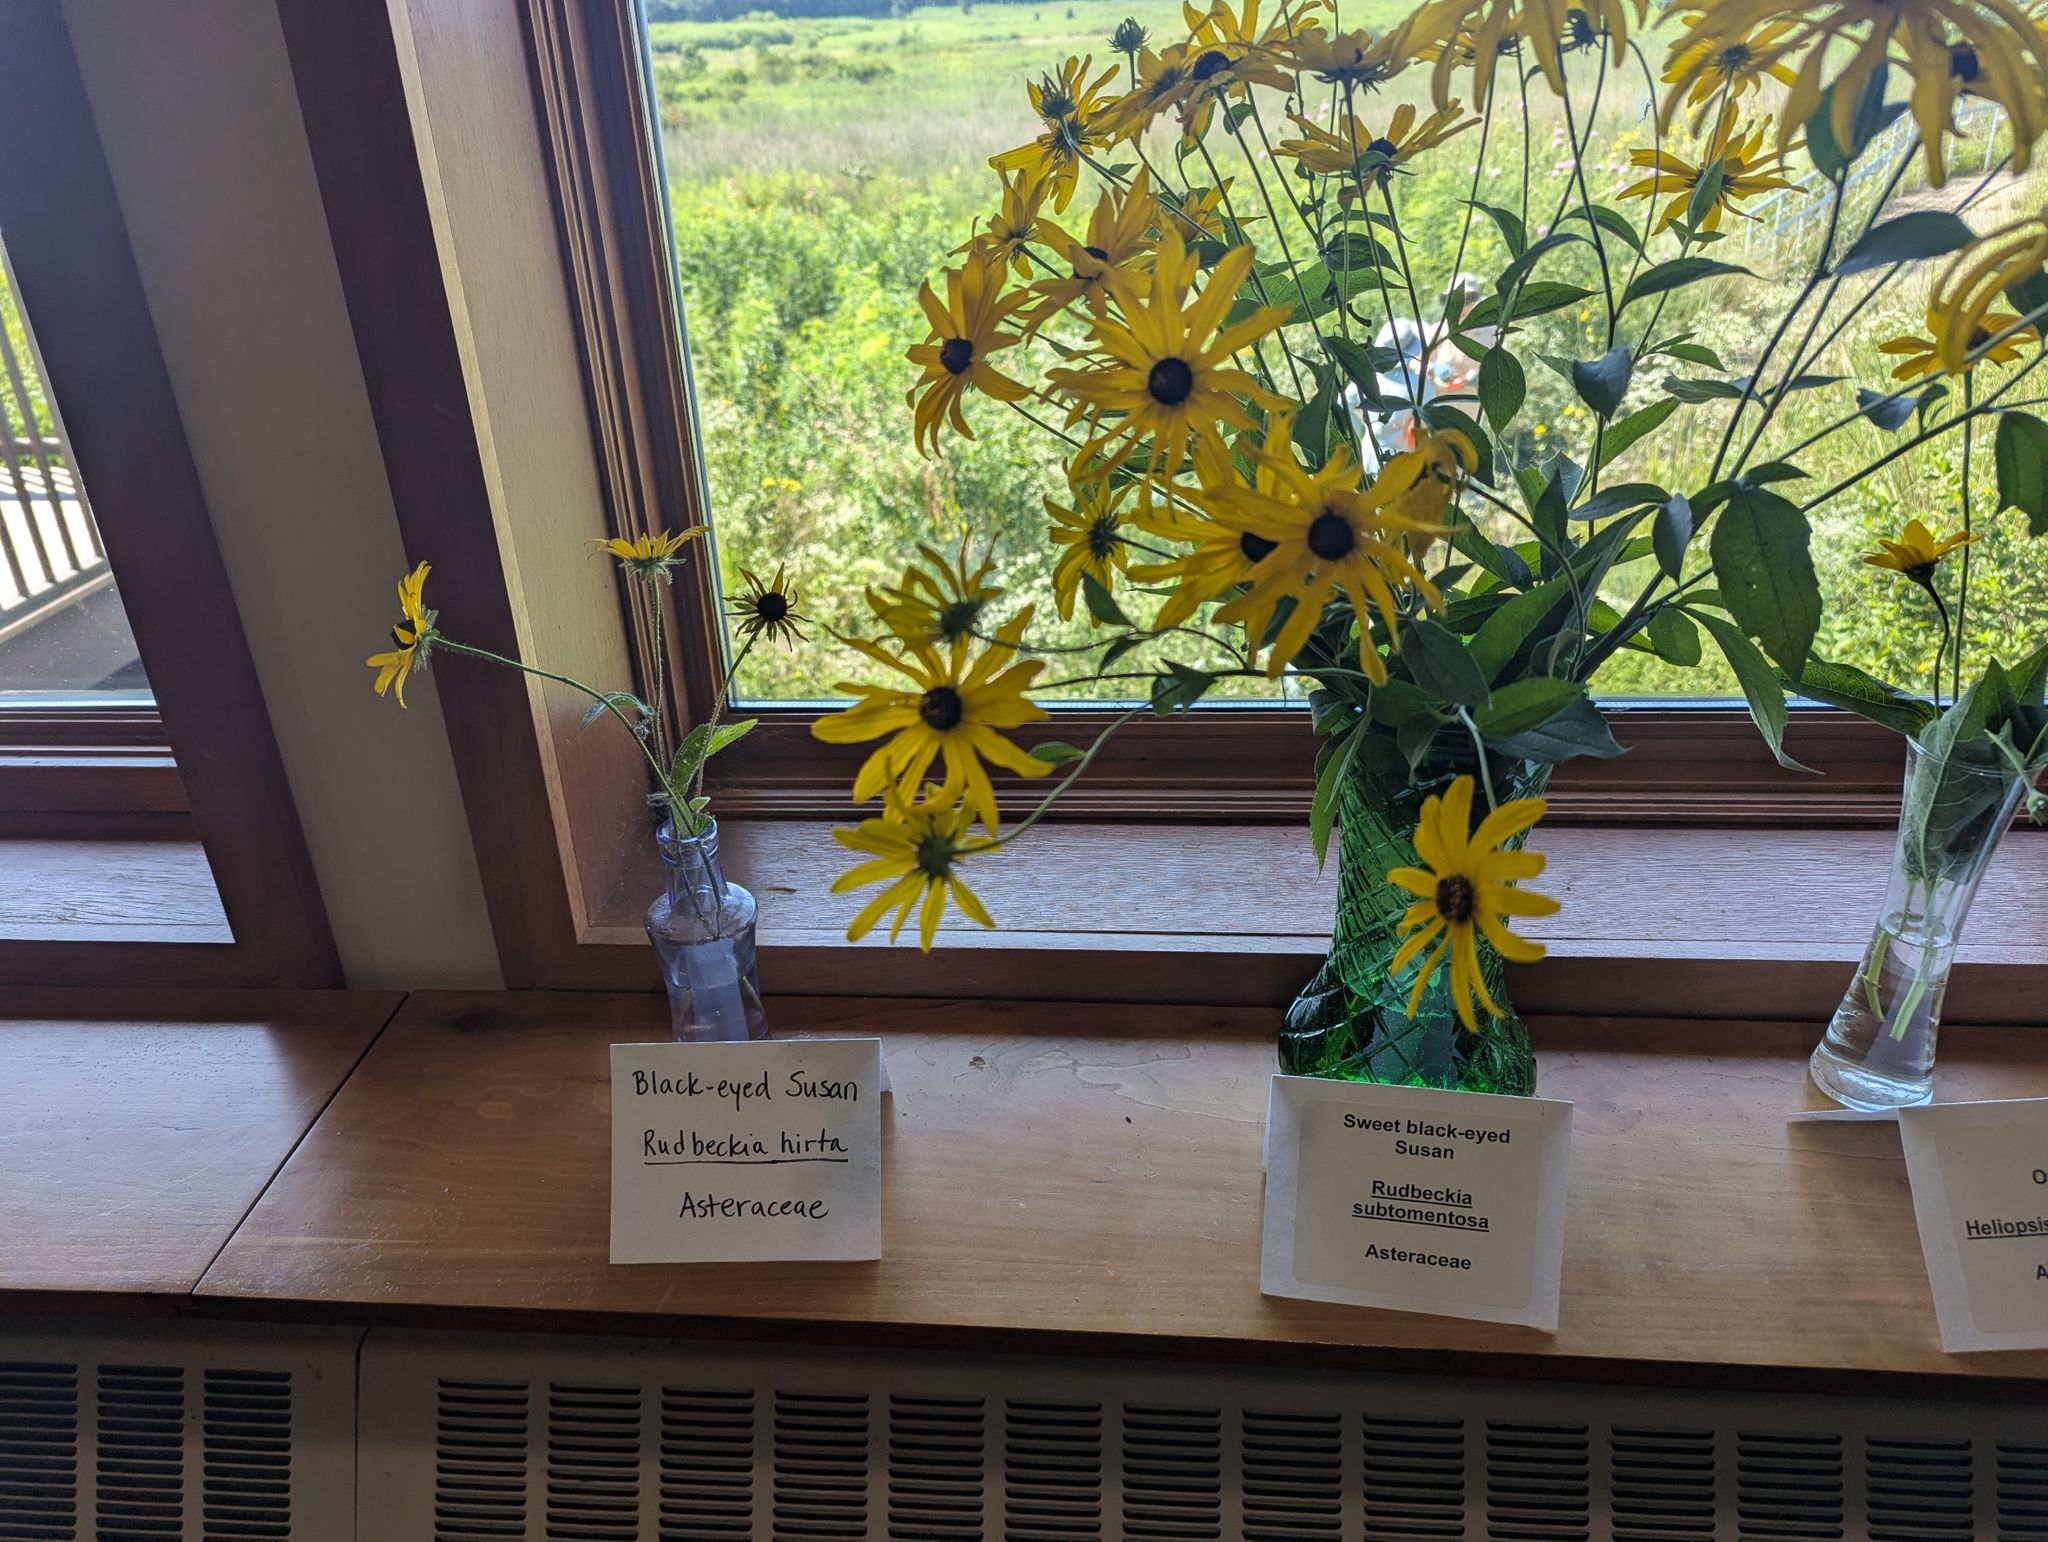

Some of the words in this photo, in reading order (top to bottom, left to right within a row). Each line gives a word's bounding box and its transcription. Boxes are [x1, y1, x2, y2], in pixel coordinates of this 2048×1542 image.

[632, 1070, 772, 1112] Black-eyed
[785, 1070, 858, 1102] Susan
[1343, 1113, 1401, 1133] Sweet
[1406, 1119, 1511, 1144] black-eyed
[644, 1129, 768, 1157] Rudbeckia
[781, 1128, 849, 1154] hirta
[1394, 1140, 1455, 1160] Susan
[679, 1192, 829, 1219] Asteraceae
[1371, 1179, 1473, 1205] Rudbeckia
[1352, 1201, 1489, 1229] subtomentosa
[1364, 1243, 1472, 1270] Asteraceae
